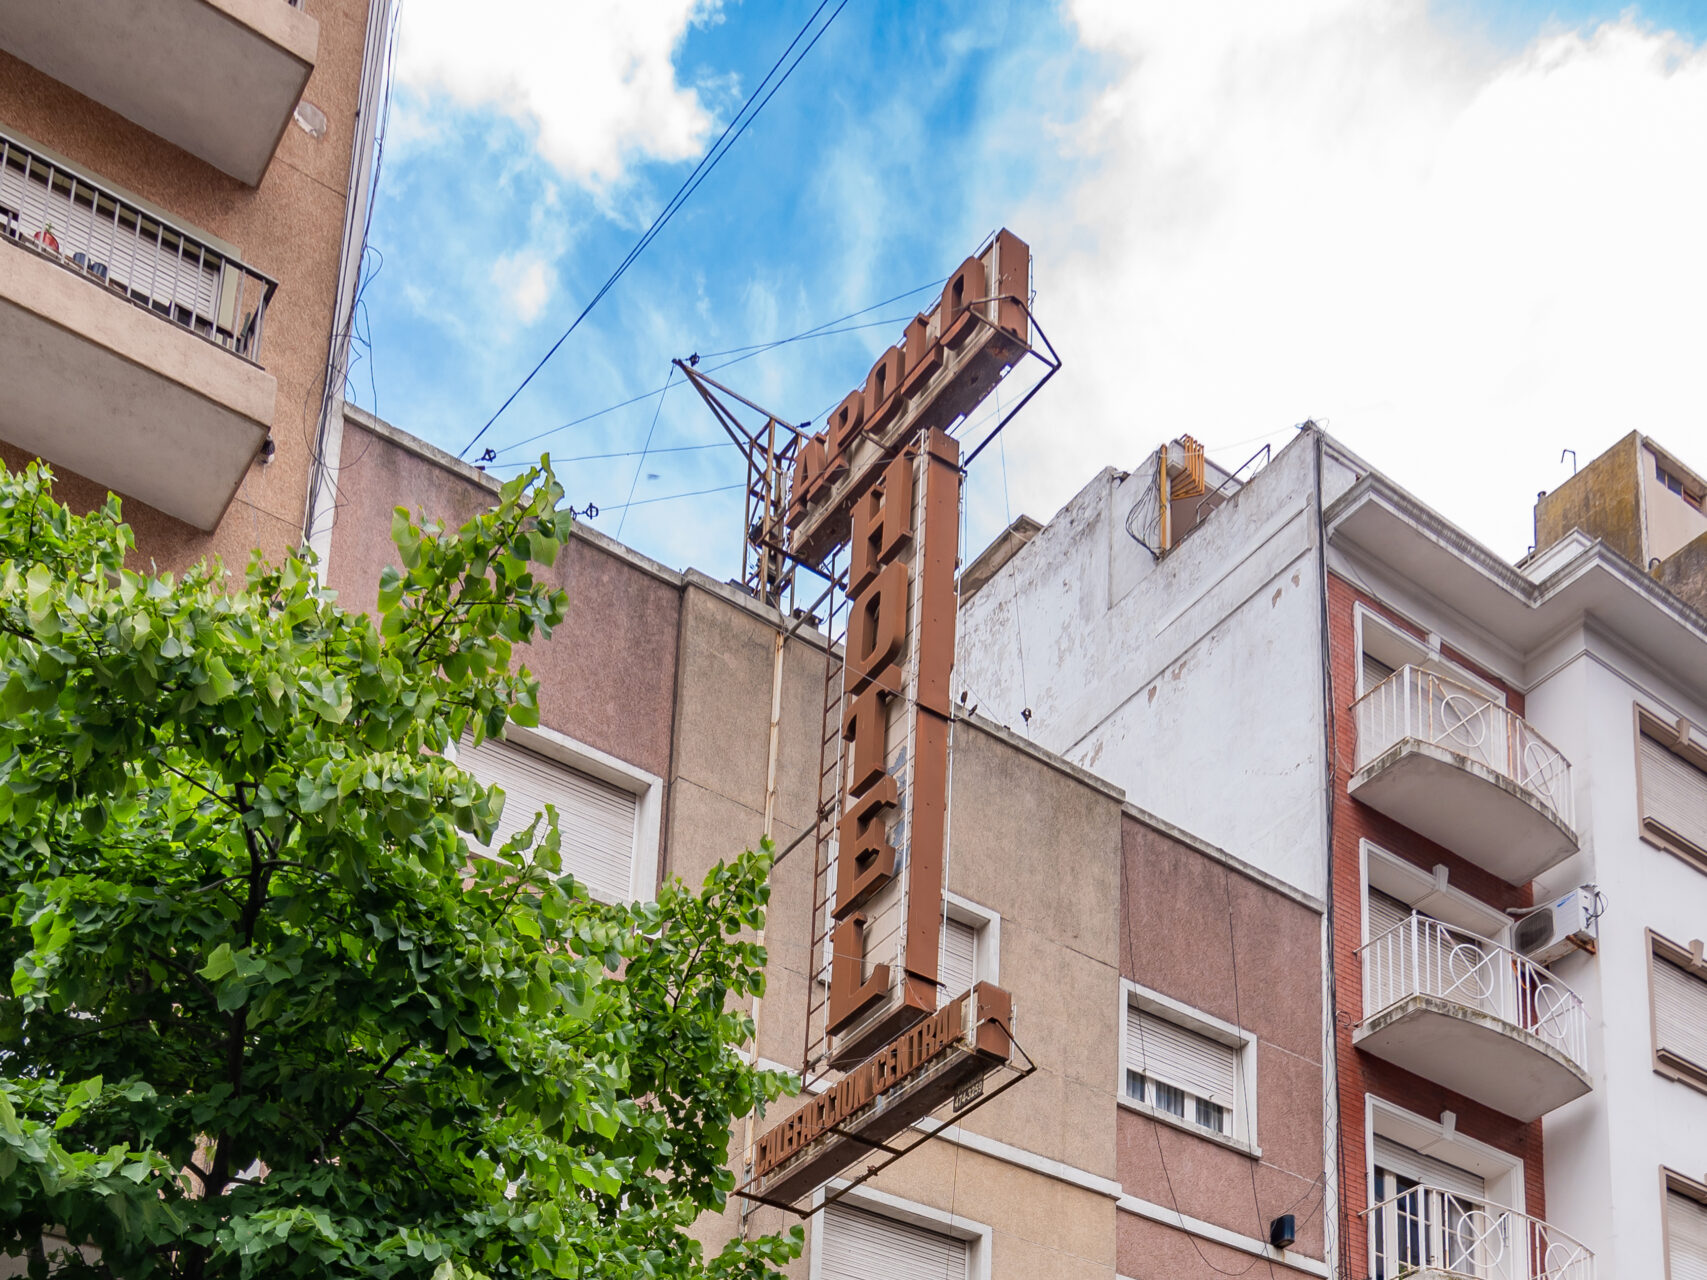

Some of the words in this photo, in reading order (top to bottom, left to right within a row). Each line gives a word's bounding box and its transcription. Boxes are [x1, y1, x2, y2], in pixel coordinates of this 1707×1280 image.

[786, 255, 986, 531] APOLO
[826, 445, 913, 1037] HOTEL
[755, 1062, 873, 1175] CALEFACCION
[872, 999, 962, 1094] CENTRAL
